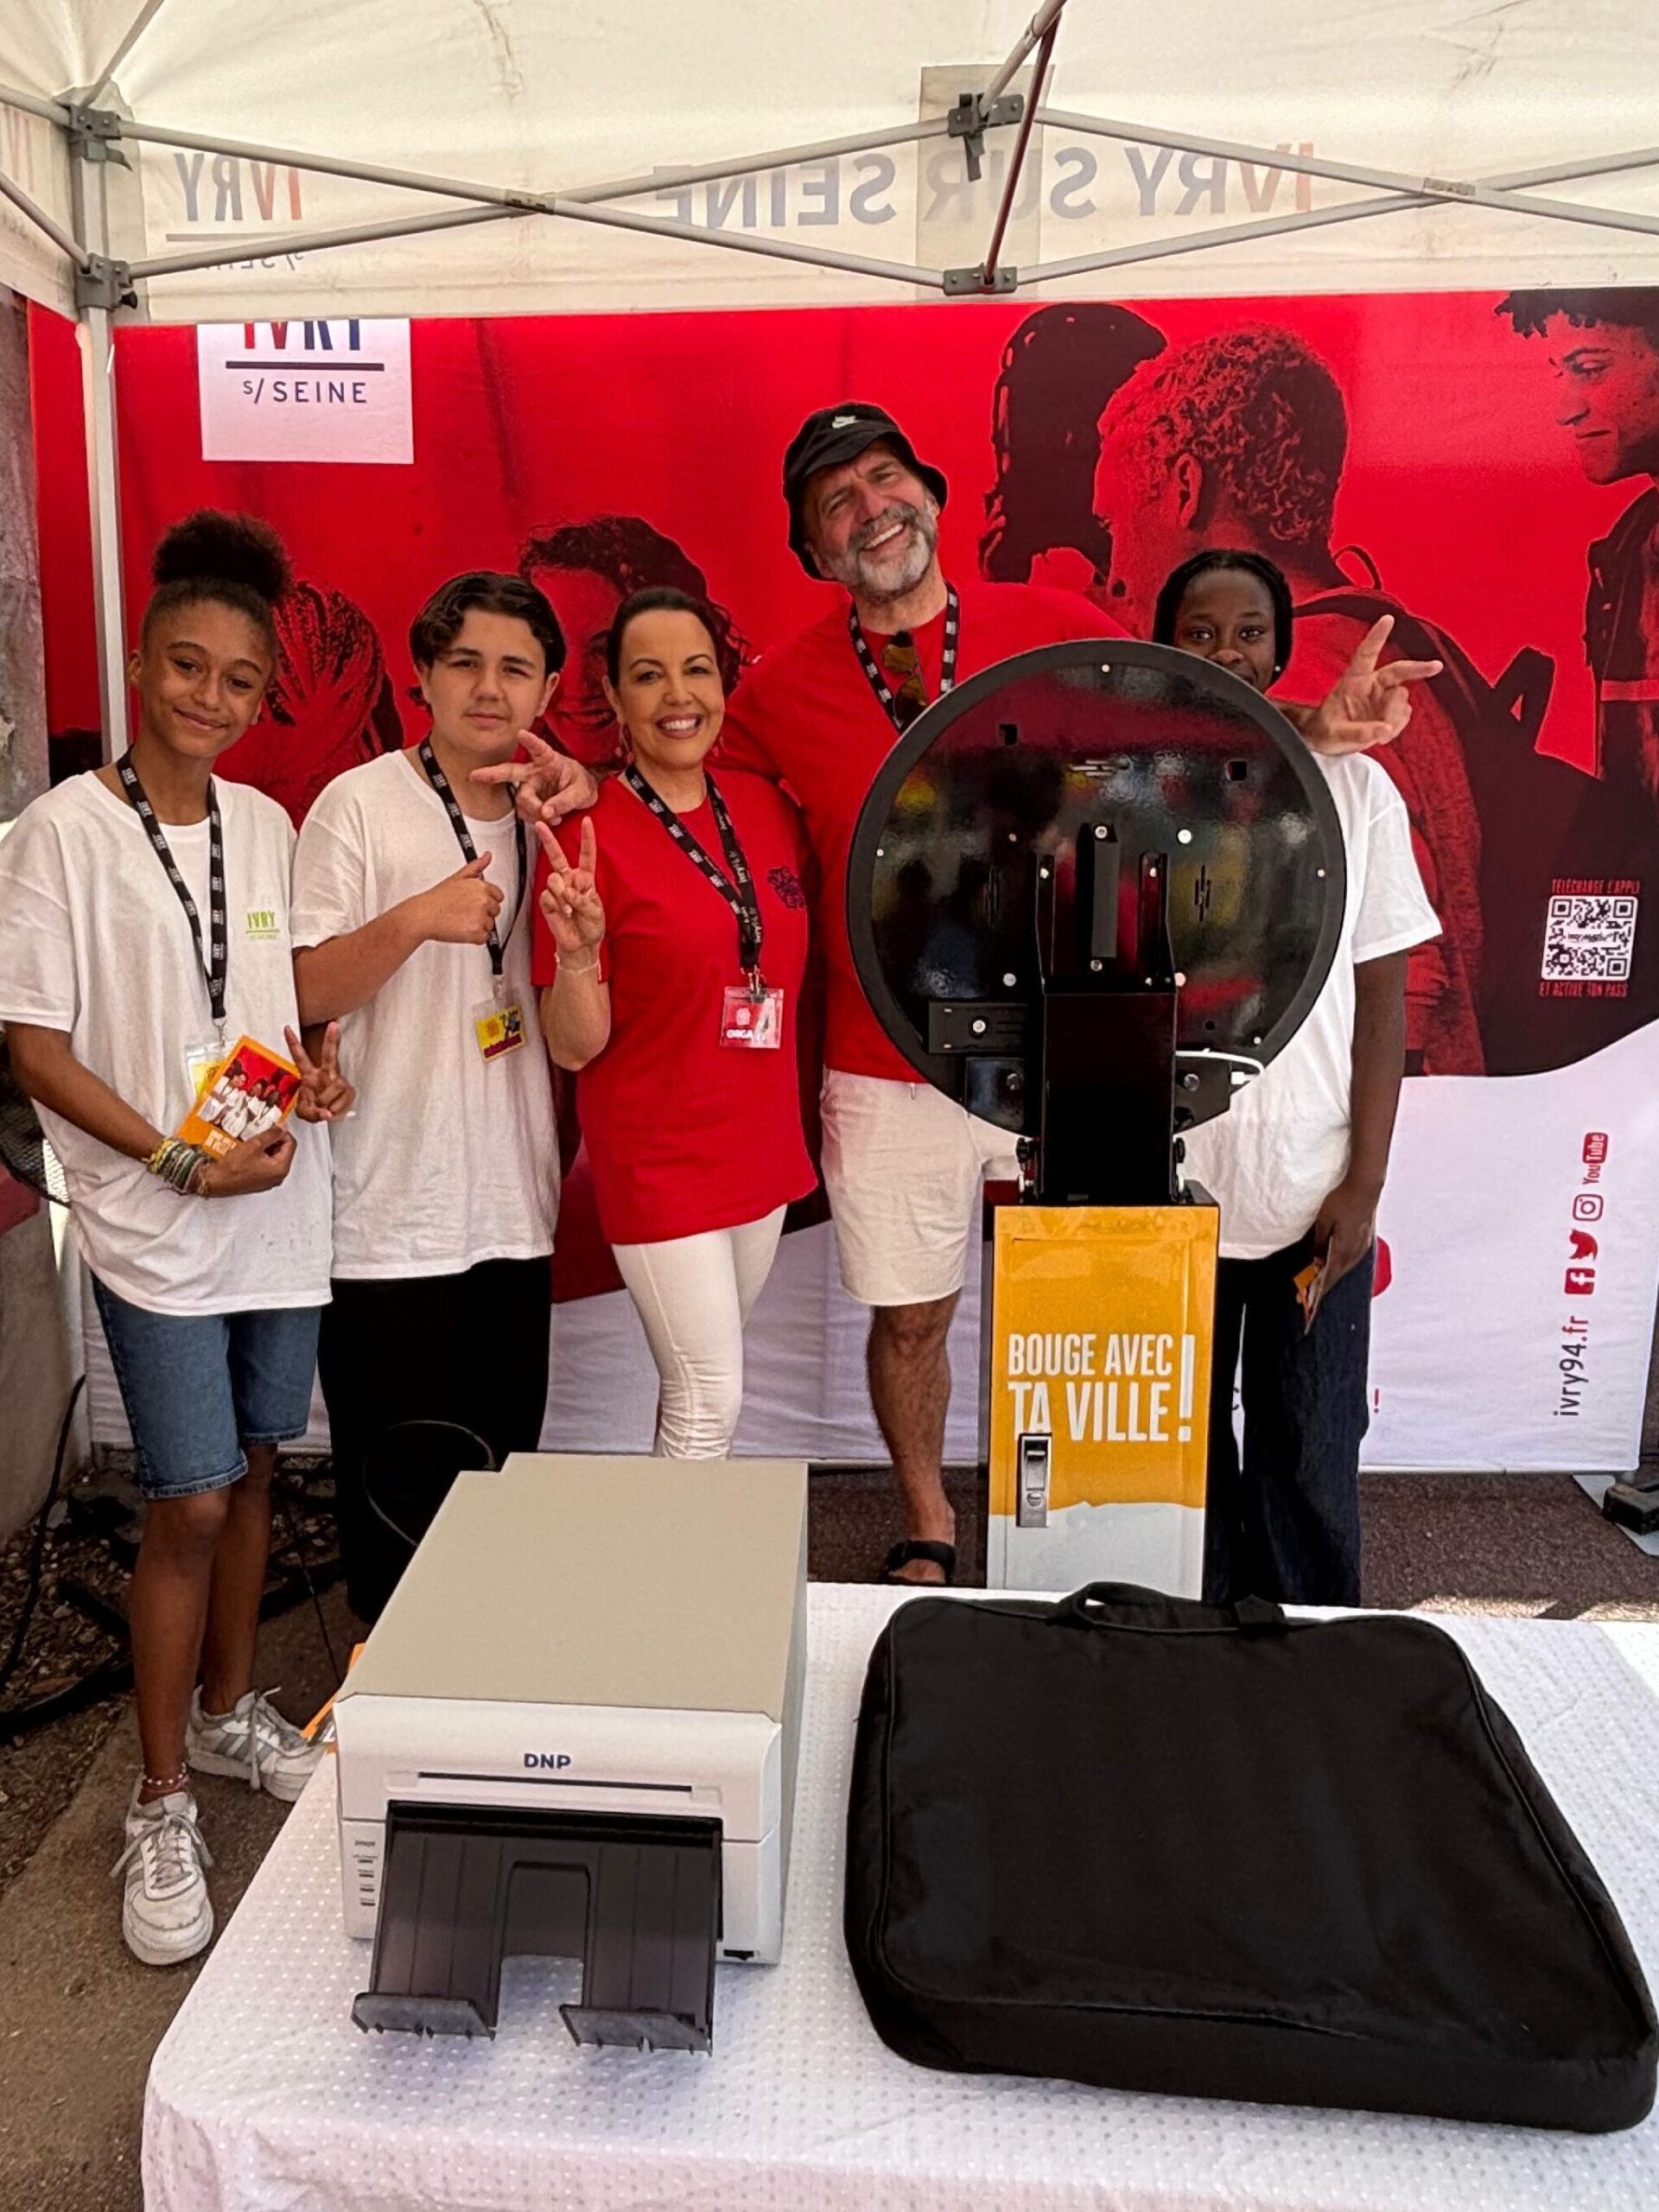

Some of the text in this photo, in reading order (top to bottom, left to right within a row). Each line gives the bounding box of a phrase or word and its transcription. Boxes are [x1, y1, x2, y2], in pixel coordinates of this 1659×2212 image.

[247, 910, 276, 929] IVRY
[1582, 1133, 1606, 1185] YouTube
[1008, 1333, 1173, 1376] BOUGE AVEC
[1554, 1316, 1589, 1416] ivry94.fr
[1007, 1381, 1052, 1441] TA
[1066, 1381, 1172, 1442] VILLE
[524, 1752, 572, 1770] DNP
